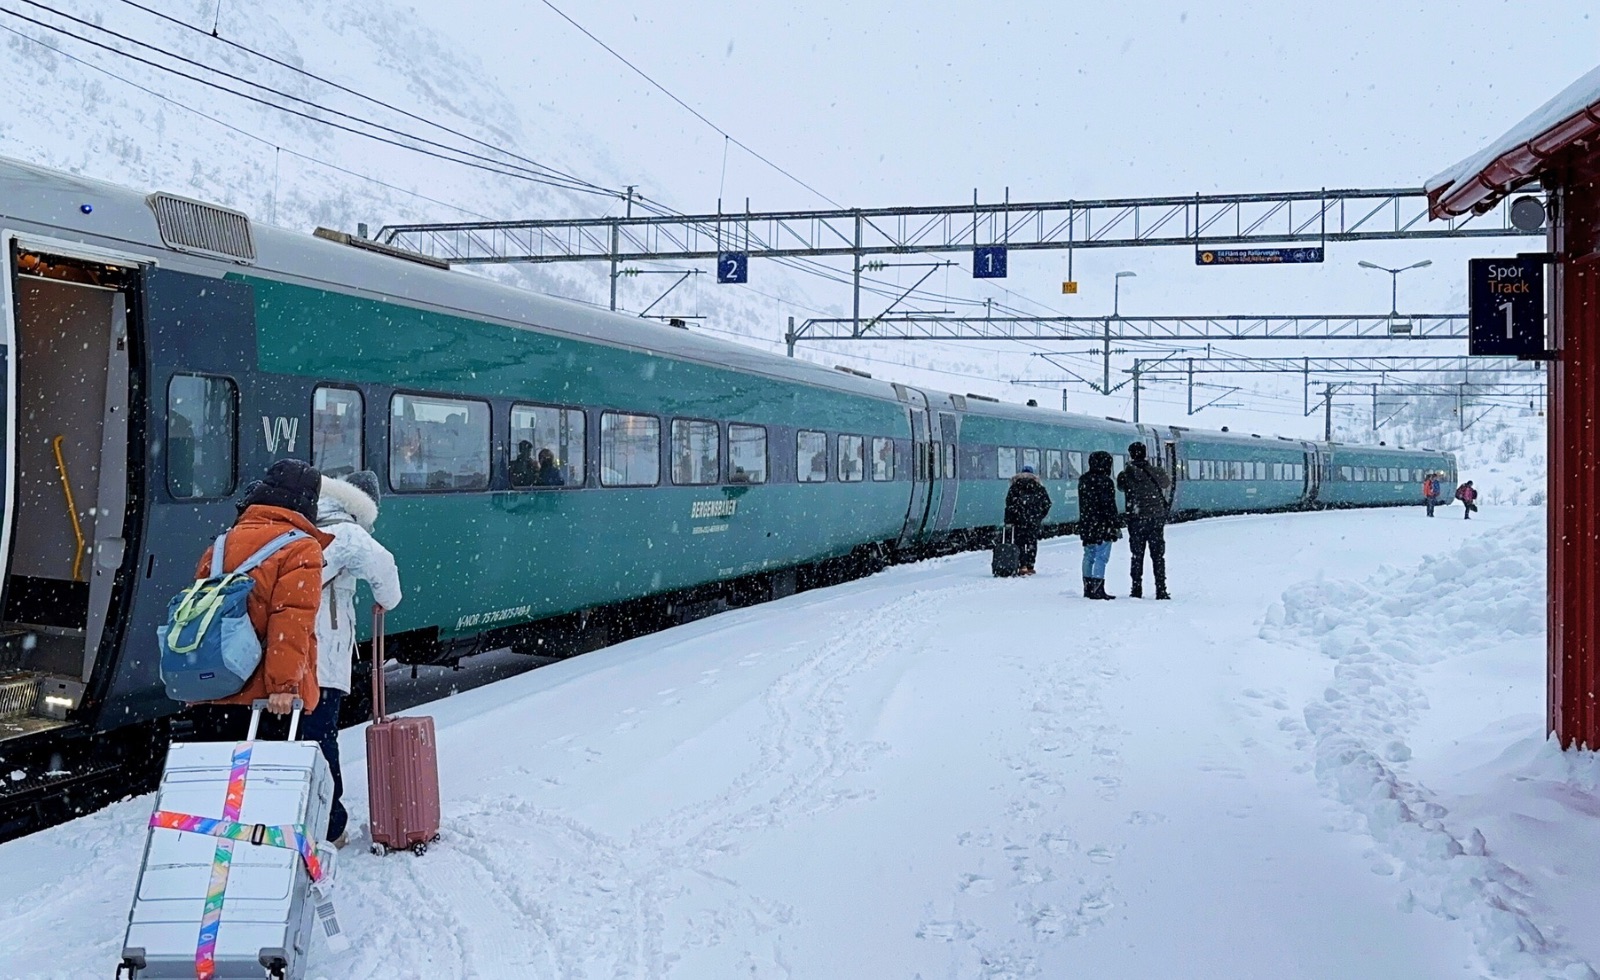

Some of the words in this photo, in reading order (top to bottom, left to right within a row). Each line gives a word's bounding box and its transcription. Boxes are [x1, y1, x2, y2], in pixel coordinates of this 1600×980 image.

[726, 259, 738, 279] 2
[984, 252, 993, 273] 1
[1488, 264, 1524, 281] Spor
[1488, 280, 1529, 293] Track
[1499, 302, 1513, 339] 1
